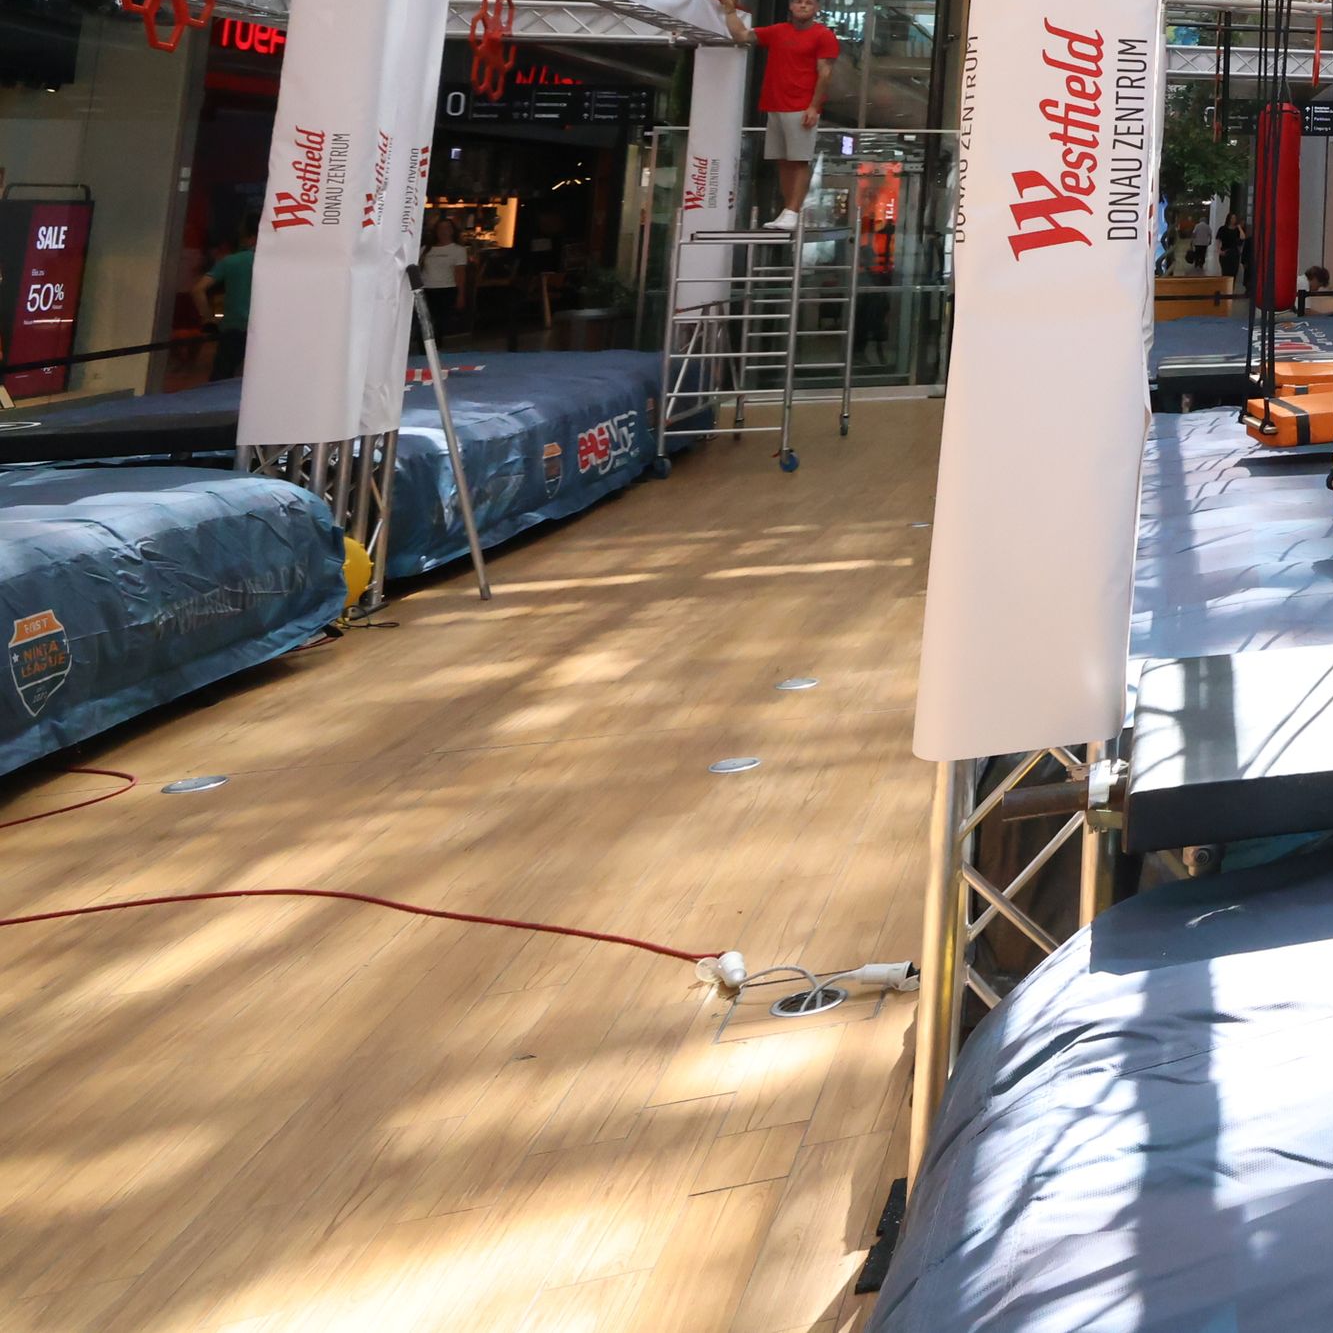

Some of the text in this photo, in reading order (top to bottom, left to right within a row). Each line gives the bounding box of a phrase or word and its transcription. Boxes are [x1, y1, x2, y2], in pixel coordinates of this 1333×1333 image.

[272, 125, 326, 232] Westfield
[322, 133, 351, 225] DONAU ZENTRUM
[684, 156, 709, 211] Westfield
[1008, 17, 1104, 261] Westfield
[1107, 39, 1148, 241] DONAU ZENTRUM
[36, 226, 68, 250] SALE
